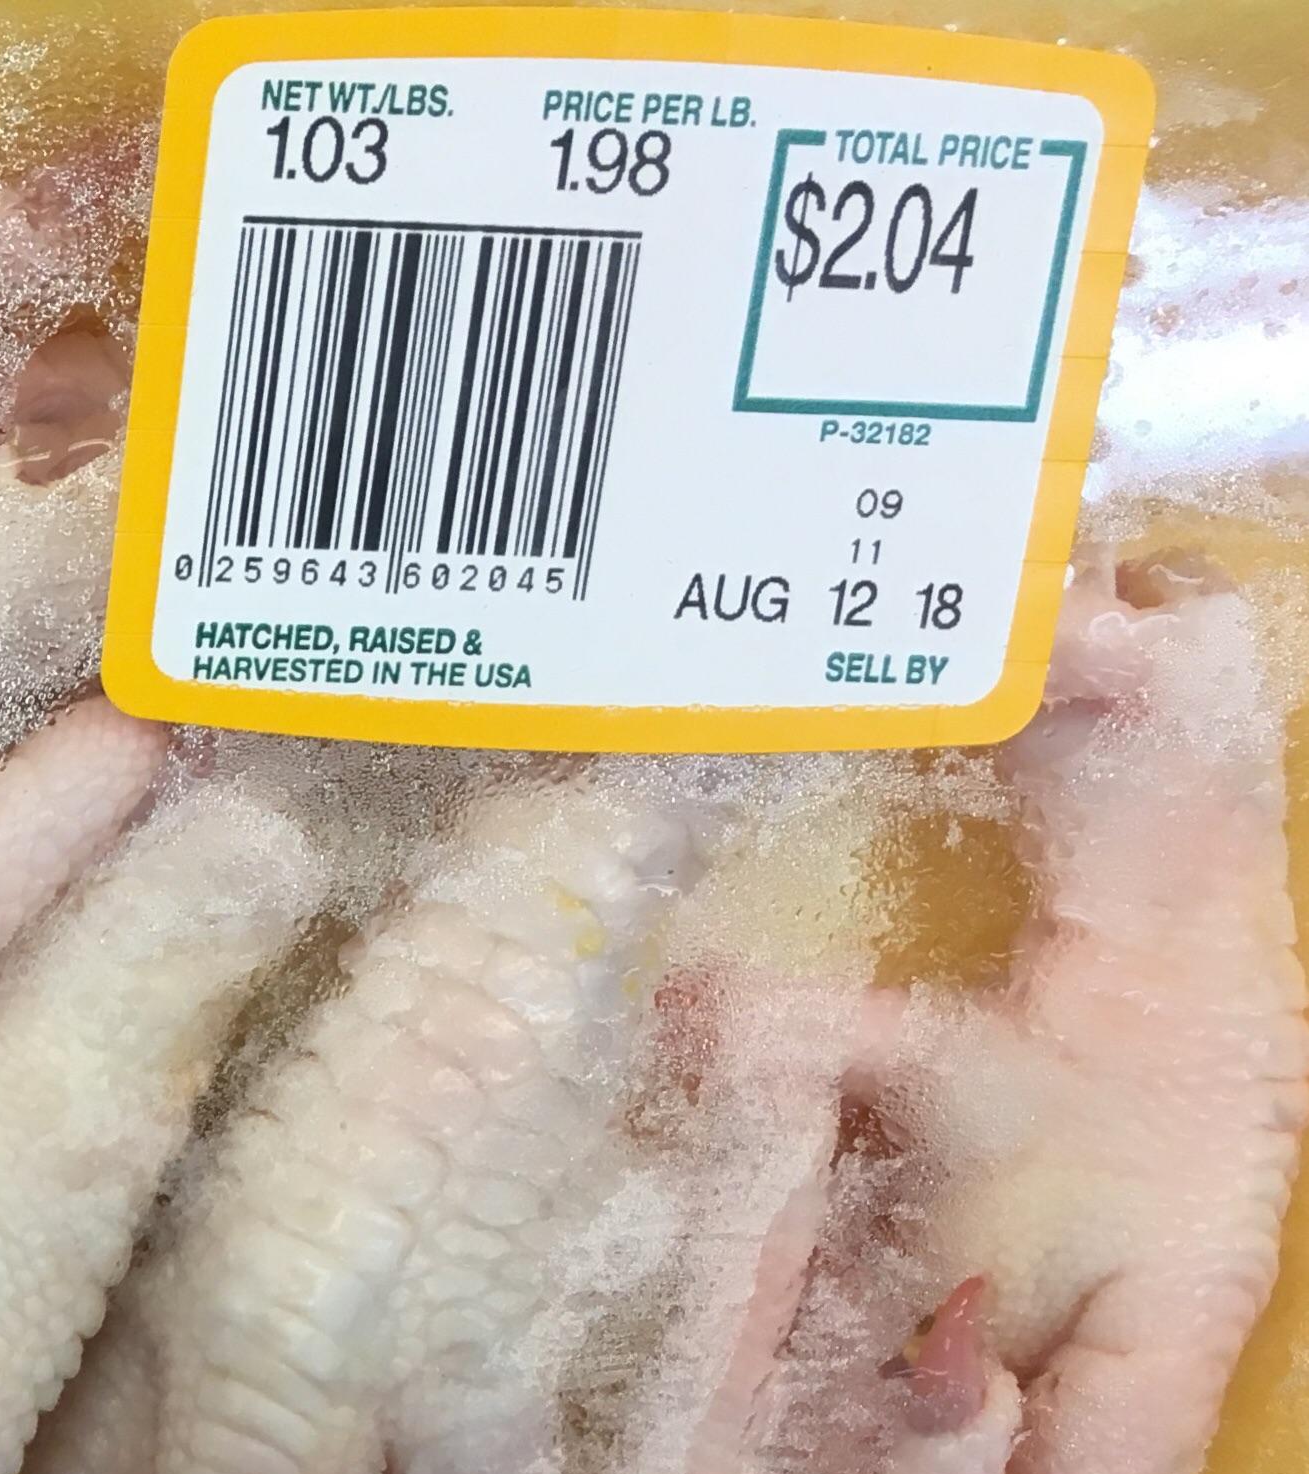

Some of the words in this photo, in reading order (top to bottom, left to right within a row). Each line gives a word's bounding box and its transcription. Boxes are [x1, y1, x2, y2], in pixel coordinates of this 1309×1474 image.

[261, 79, 322, 111] NET
[543, 90, 634, 123] PRICE
[641, 93, 702, 126] PER
[710, 96, 758, 128] LB.
[265, 115, 389, 185] 1.03
[550, 127, 672, 197] 1.98
[835, 129, 928, 165] TOTAL
[938, 134, 1033, 170] PRICE
[774, 171, 978, 302] $2.04
[819, 419, 932, 446] P-32182
[856, 488, 904, 519] 09
[851, 538, 882, 565] 11
[174, 553, 194, 581] 0
[214, 556, 378, 588] 259643
[403, 562, 565, 594] 602045
[673, 572, 790, 624] AUG
[828, 578, 878, 627] 12
[915, 582, 964, 630] 18
[195, 622, 340, 655] HATCHED,
[348, 626, 456, 655] RAISED
[463, 629, 483, 656] &
[193, 656, 364, 684] HARVESTED
[372, 661, 401, 685] IN
[410, 662, 467, 686] THE
[474, 663, 532, 688] USA
[825, 651, 897, 684] SELL
[905, 654, 949, 685] BY
